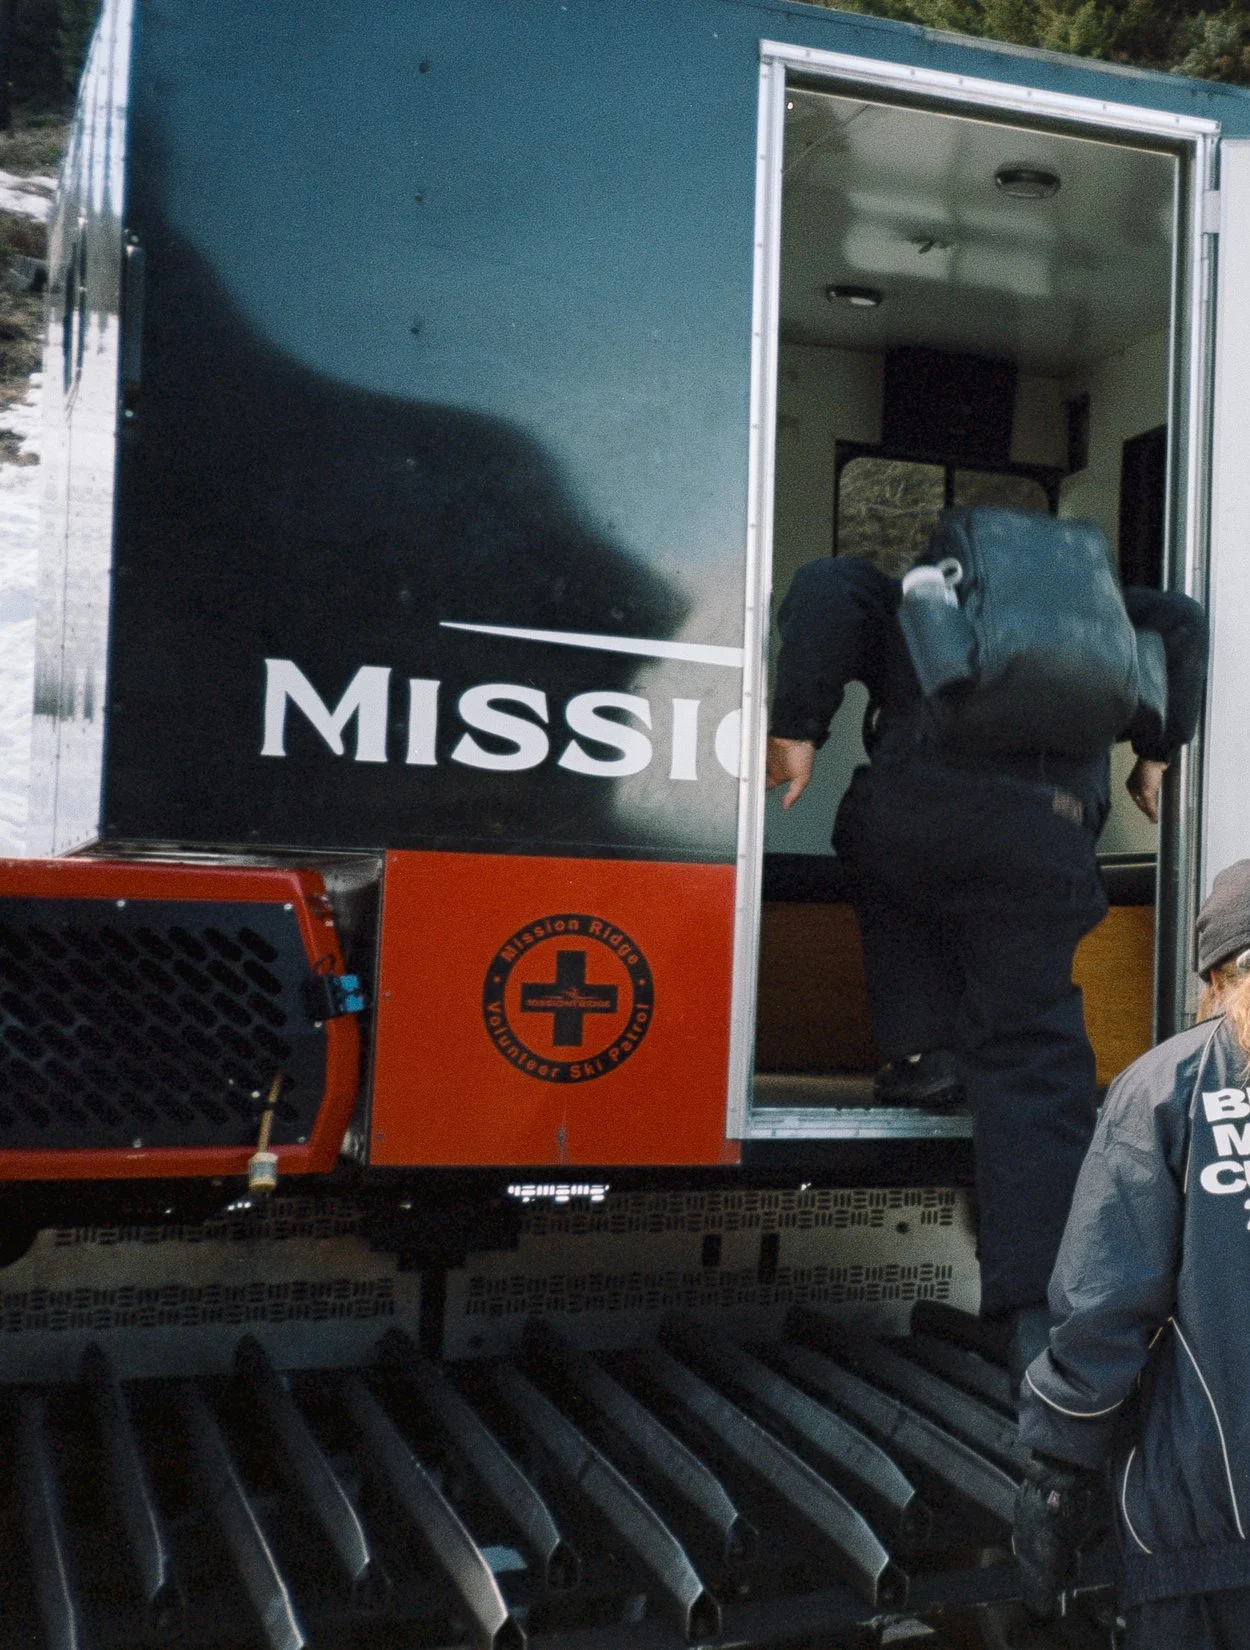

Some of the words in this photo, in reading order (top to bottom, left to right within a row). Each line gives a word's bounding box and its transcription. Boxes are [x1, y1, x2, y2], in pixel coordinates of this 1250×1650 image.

[260, 658, 741, 783] MISSI
[501, 919, 580, 961] Mission
[588, 920, 639, 965] Ridge
[487, 1000, 561, 1078] Volunteer
[569, 1058, 604, 1079] Ski
[608, 1003, 650, 1062] Patrol
